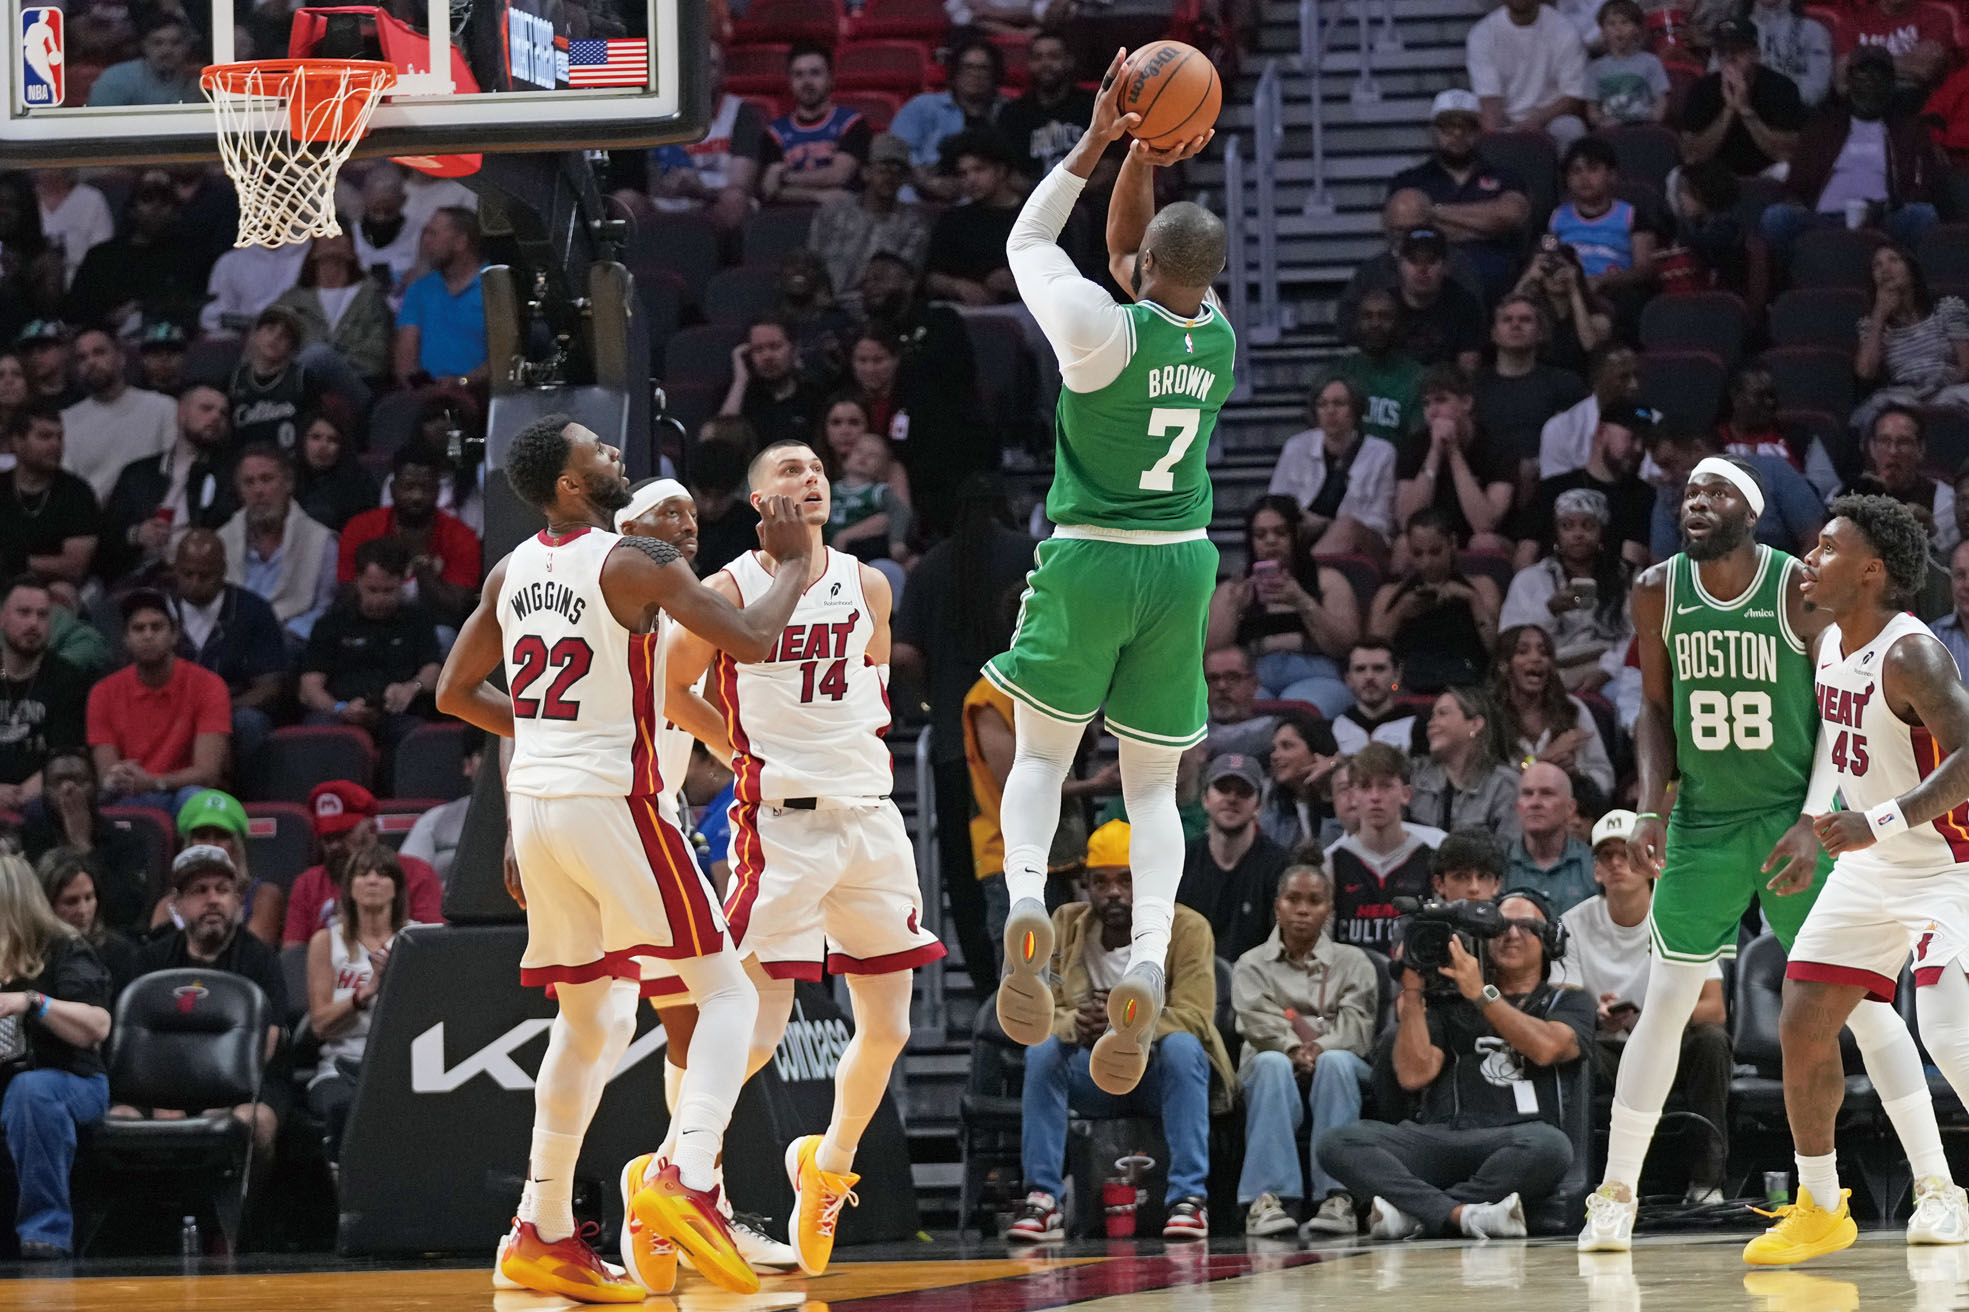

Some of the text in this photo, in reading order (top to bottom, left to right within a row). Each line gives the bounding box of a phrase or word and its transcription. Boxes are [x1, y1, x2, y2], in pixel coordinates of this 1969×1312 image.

[27, 84, 49, 101] NBA
[1127, 46, 1181, 104] Wilson
[1149, 364, 1216, 402] BROWN
[1138, 407, 1201, 492] 7
[511, 581, 586, 625] WIGGINS
[1744, 607, 1775, 618] Amica
[510, 634, 594, 721] 22
[799, 657, 848, 704] 14
[1675, 630, 1777, 684] BOSTON
[1689, 689, 1774, 751] 88
[1831, 730, 1870, 777] 45
[337, 967, 370, 990] HE
